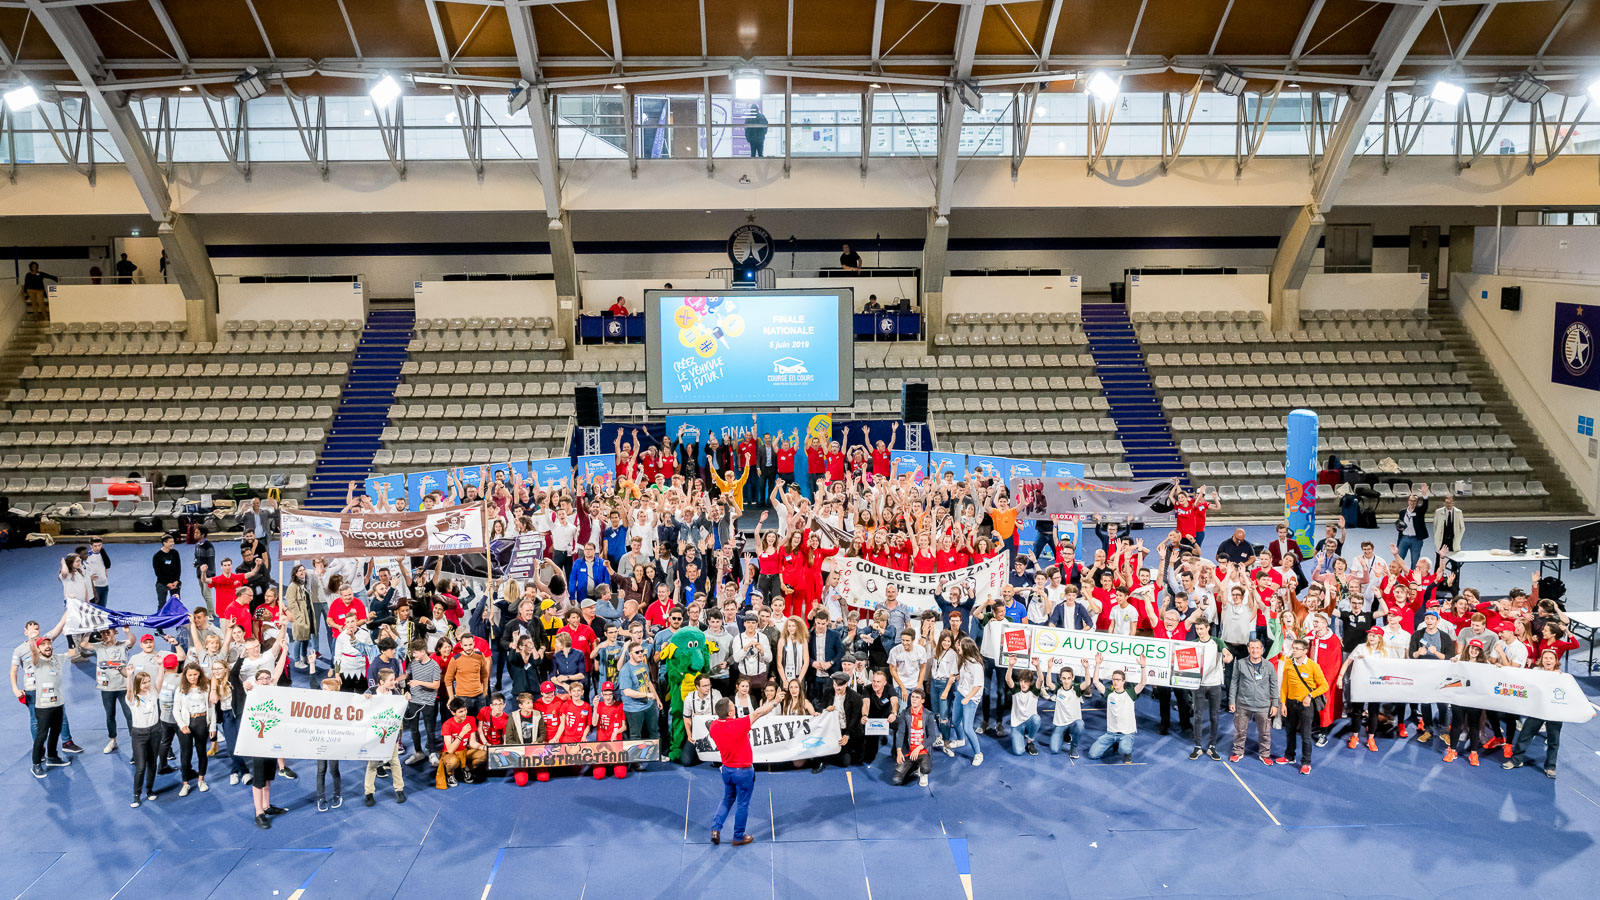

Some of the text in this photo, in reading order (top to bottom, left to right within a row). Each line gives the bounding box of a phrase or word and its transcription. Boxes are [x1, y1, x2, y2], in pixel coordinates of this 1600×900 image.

[733, 226, 769, 238] PARIS VOLLEY
[772, 315, 805, 324] FINALE
[763, 326, 815, 335] NATIONALE
[1566, 323, 1590, 337] PARIS VOLLEY
[774, 341, 790, 350] juin
[673, 356, 696, 374] CRÉEZ
[677, 356, 725, 383] LE VÉHICULE
[682, 382, 692, 393] DU
[694, 372, 718, 390] FUTUR
[364, 520, 402, 530] COLLÈGE
[342, 528, 425, 540] VICTOR HUGO
[365, 540, 404, 548] SARCELLES
[856, 561, 911, 582] COLLEGE
[1062, 636, 1166, 660] AUTOSHOES
[1494, 686, 1528, 698] SURPRISE
[290, 701, 364, 722] Wood & Co
[294, 727, 315, 736] Collège
[748, 718, 812, 746] EAKY'S
